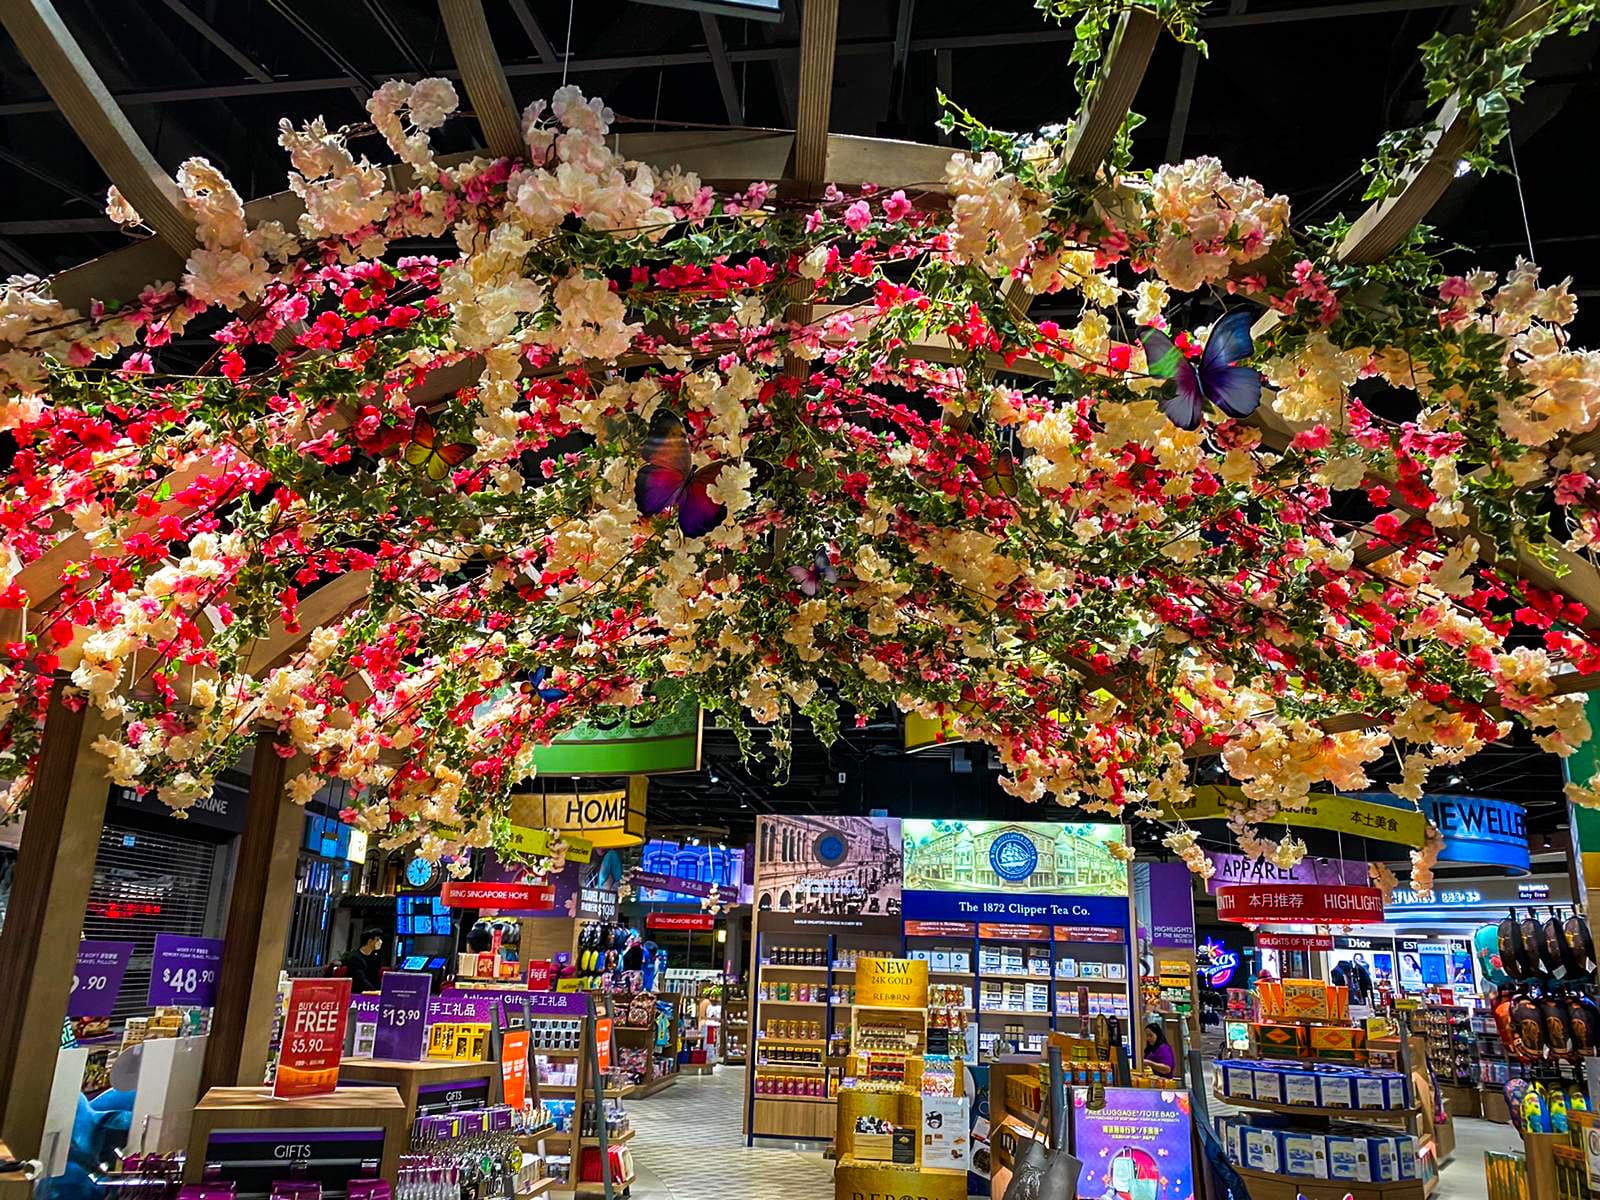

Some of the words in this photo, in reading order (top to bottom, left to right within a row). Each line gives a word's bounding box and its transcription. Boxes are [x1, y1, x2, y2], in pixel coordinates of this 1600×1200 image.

[566, 798, 626, 824] HOME
[1351, 811, 1399, 831] 本土美食
[1223, 859, 1300, 880] APPAREL
[467, 890, 508, 899] SINGAPORE
[508, 892, 529, 900] HOME
[1248, 893, 1304, 909] 本月推荐
[958, 901, 979, 912] The
[983, 902, 1006, 913] 1872
[1008, 904, 1047, 917] Clipper
[1050, 905, 1069, 915] Tea
[1072, 906, 1091, 916] Co.
[1324, 894, 1383, 911] HIGHLIGHTS
[1302, 938, 1315, 946] THE
[1348, 938, 1371, 949] Dior
[1403, 941, 1417, 950] EST
[875, 961, 910, 974] NEW
[162, 967, 215, 993] $48.90
[872, 976, 886, 984] 24K
[887, 977, 912, 985] GOLD
[530, 995, 567, 1007] 手工礼品
[873, 992, 910, 1001] REBORN
[298, 1002, 314, 1010] BUY
[315, 1002, 320, 1010] 4
[321, 1002, 335, 1010] GET
[429, 1002, 476, 1016] 手工礼品
[294, 1011, 339, 1033] FREE
[382, 1009, 420, 1026] $13.90
[291, 1038, 324, 1053] $5.90
[445, 1090, 463, 1102] GIFTS
[274, 1145, 312, 1158] GIFTS
